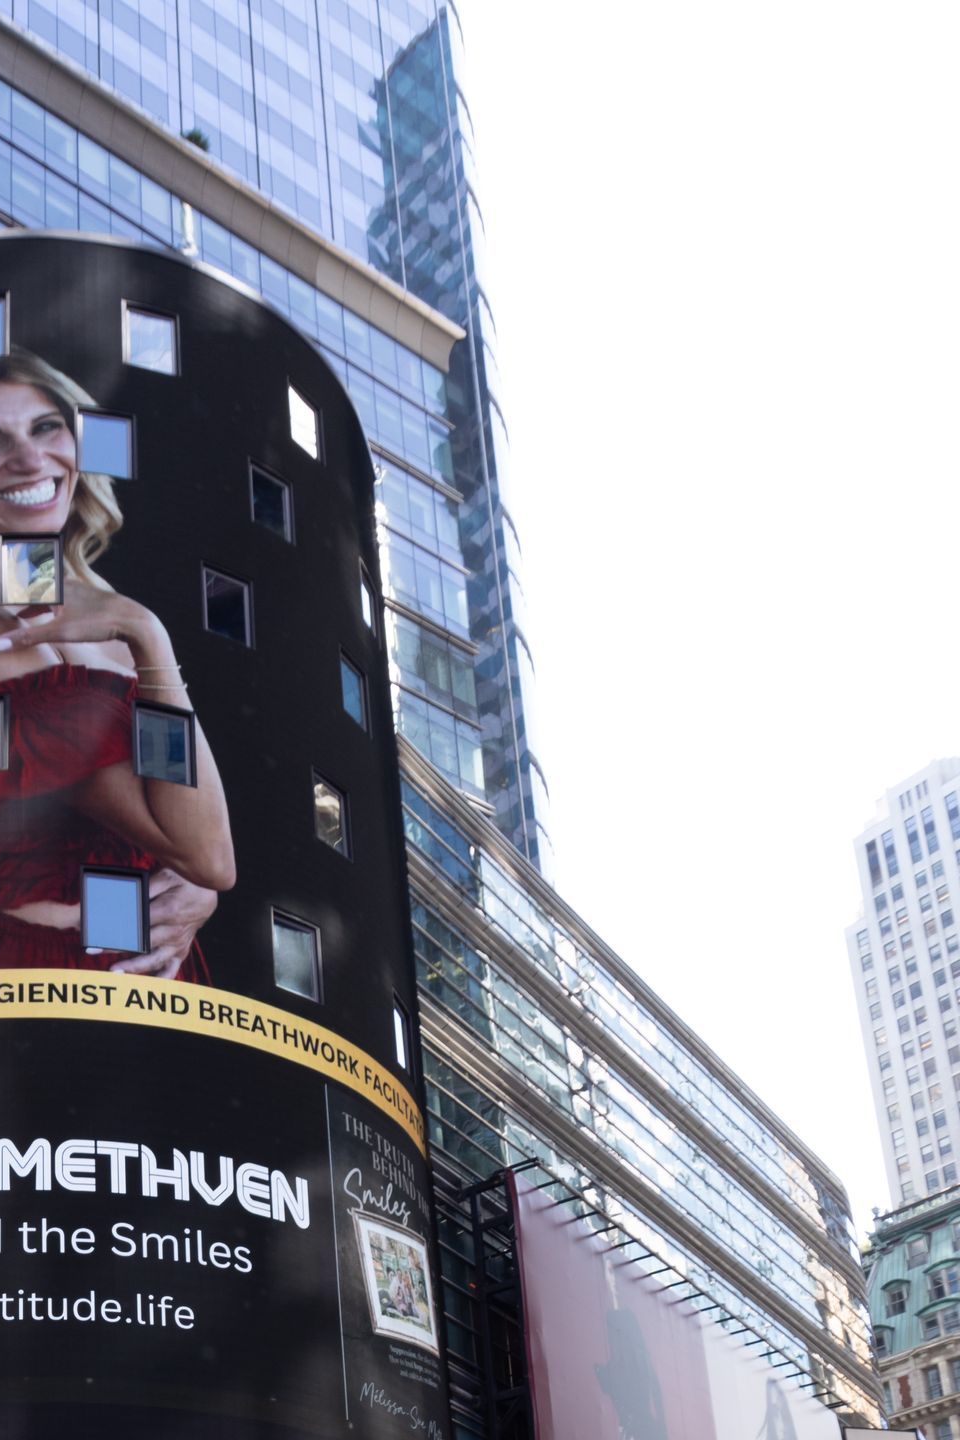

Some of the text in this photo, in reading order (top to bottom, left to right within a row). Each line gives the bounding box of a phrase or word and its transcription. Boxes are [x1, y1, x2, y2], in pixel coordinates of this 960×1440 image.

[125, 988, 190, 1016] AND
[198, 1001, 361, 1080] BREATHWORK
[342, 1112, 416, 1181] THE TRUTH
[372, 1151, 416, 1201] BEHIND
[343, 1167, 411, 1227] Smiles
[18, 1218, 96, 1254] the
[111, 1222, 253, 1273] Smiles
